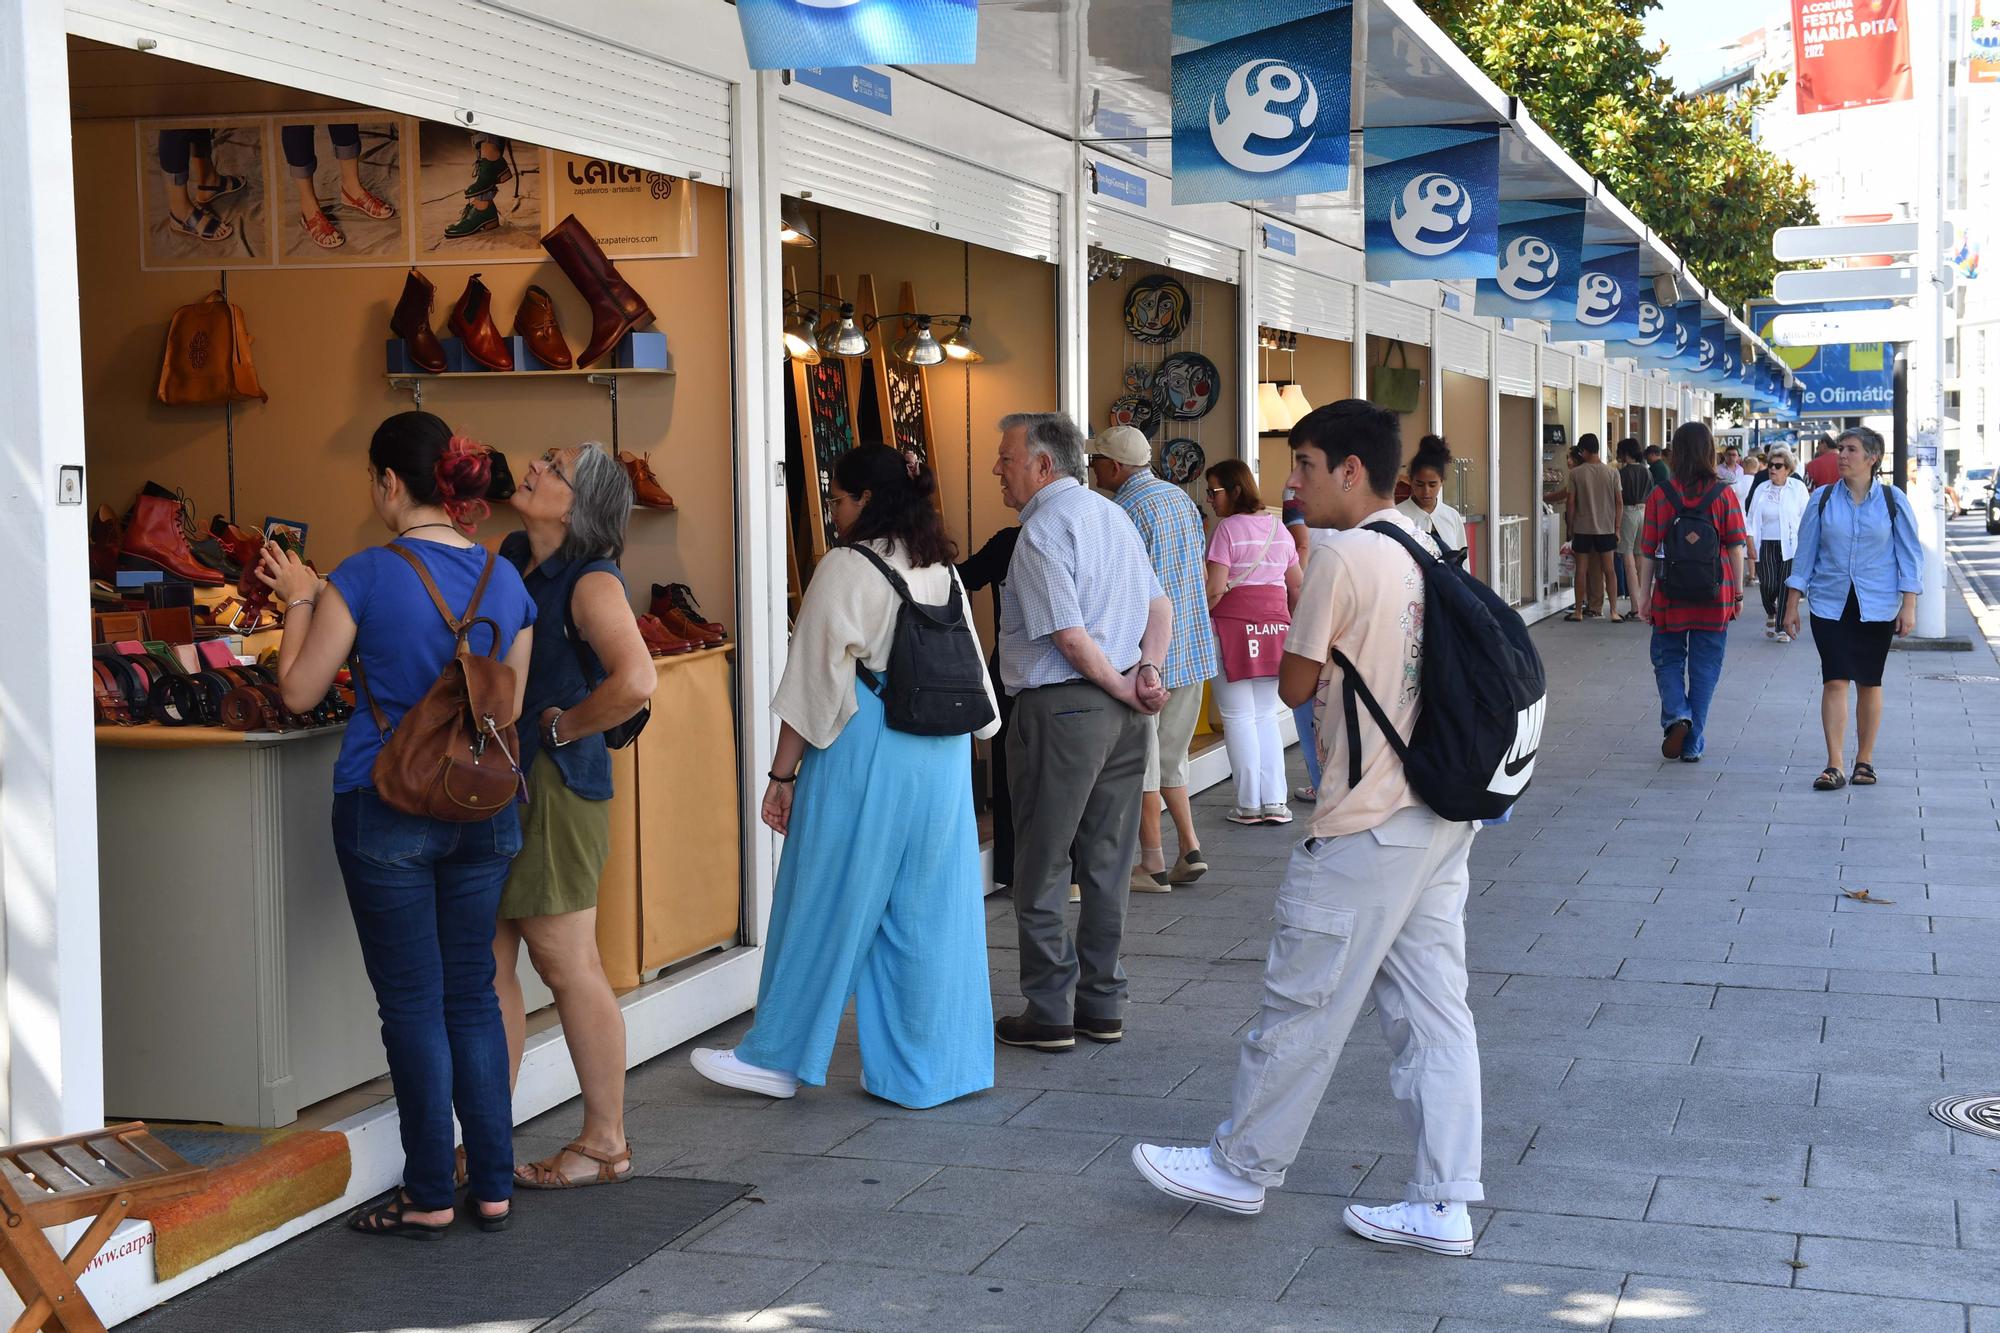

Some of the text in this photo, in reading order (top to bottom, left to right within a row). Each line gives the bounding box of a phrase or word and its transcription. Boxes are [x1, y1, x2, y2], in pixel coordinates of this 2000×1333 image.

[1802, 5, 1809, 14] A
[1802, 10, 1853, 27] FESTAS
[1860, 18, 1897, 36] PITA
[1804, 43, 1824, 59] 2022
[574, 187, 608, 195] zapateiros
[1820, 385, 1894, 403] Ofimátic
[1248, 639, 1260, 658] B
